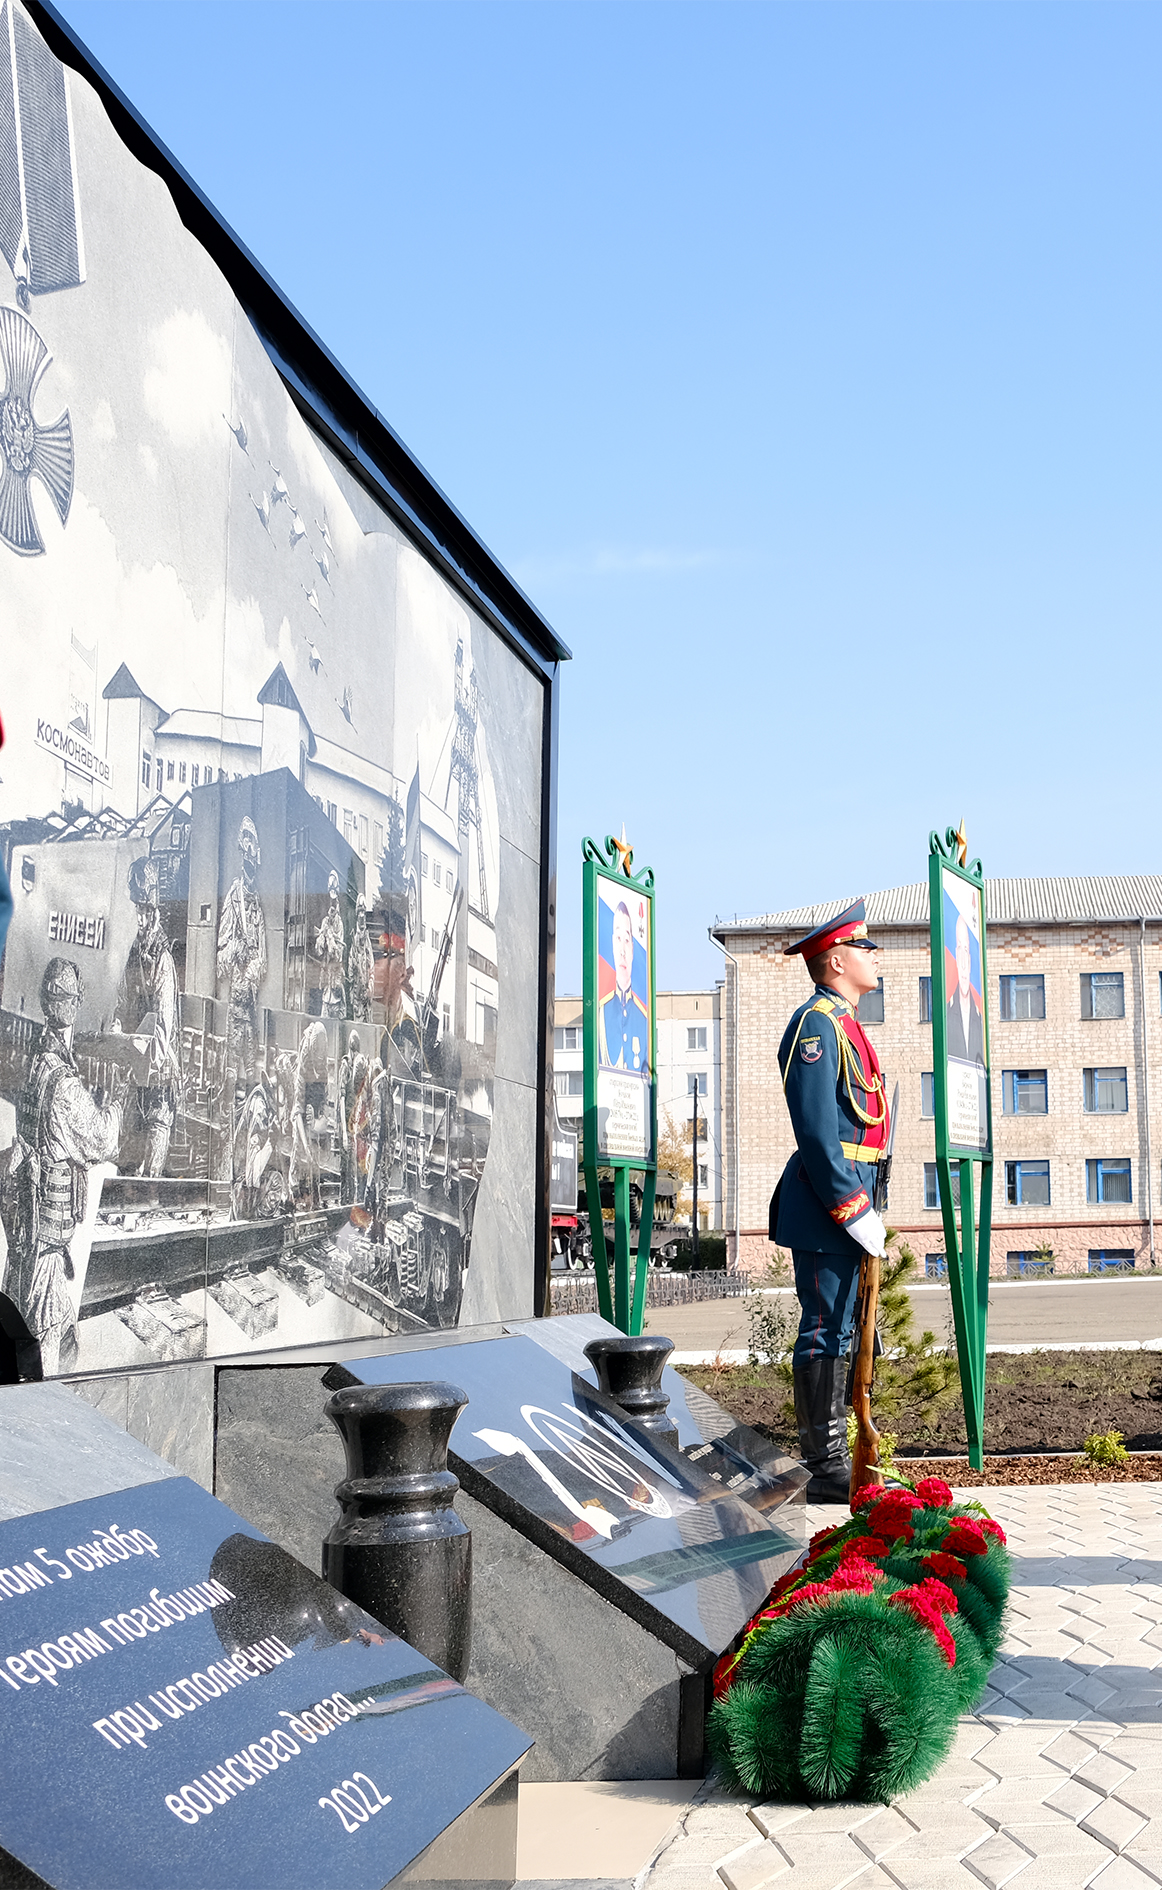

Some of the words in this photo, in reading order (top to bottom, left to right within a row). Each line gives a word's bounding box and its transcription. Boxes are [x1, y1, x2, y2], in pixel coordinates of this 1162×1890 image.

[48, 910, 106, 950] ЕНИСЕЙ
[33, 1547, 73, 1580] 5
[99, 1578, 236, 1646] погибшим
[92, 1701, 163, 1750] при
[148, 1634, 296, 1720] исполнении
[164, 1728, 302, 1825] воинского
[278, 1691, 376, 1745] долга...
[318, 1771, 393, 1834] 2022
